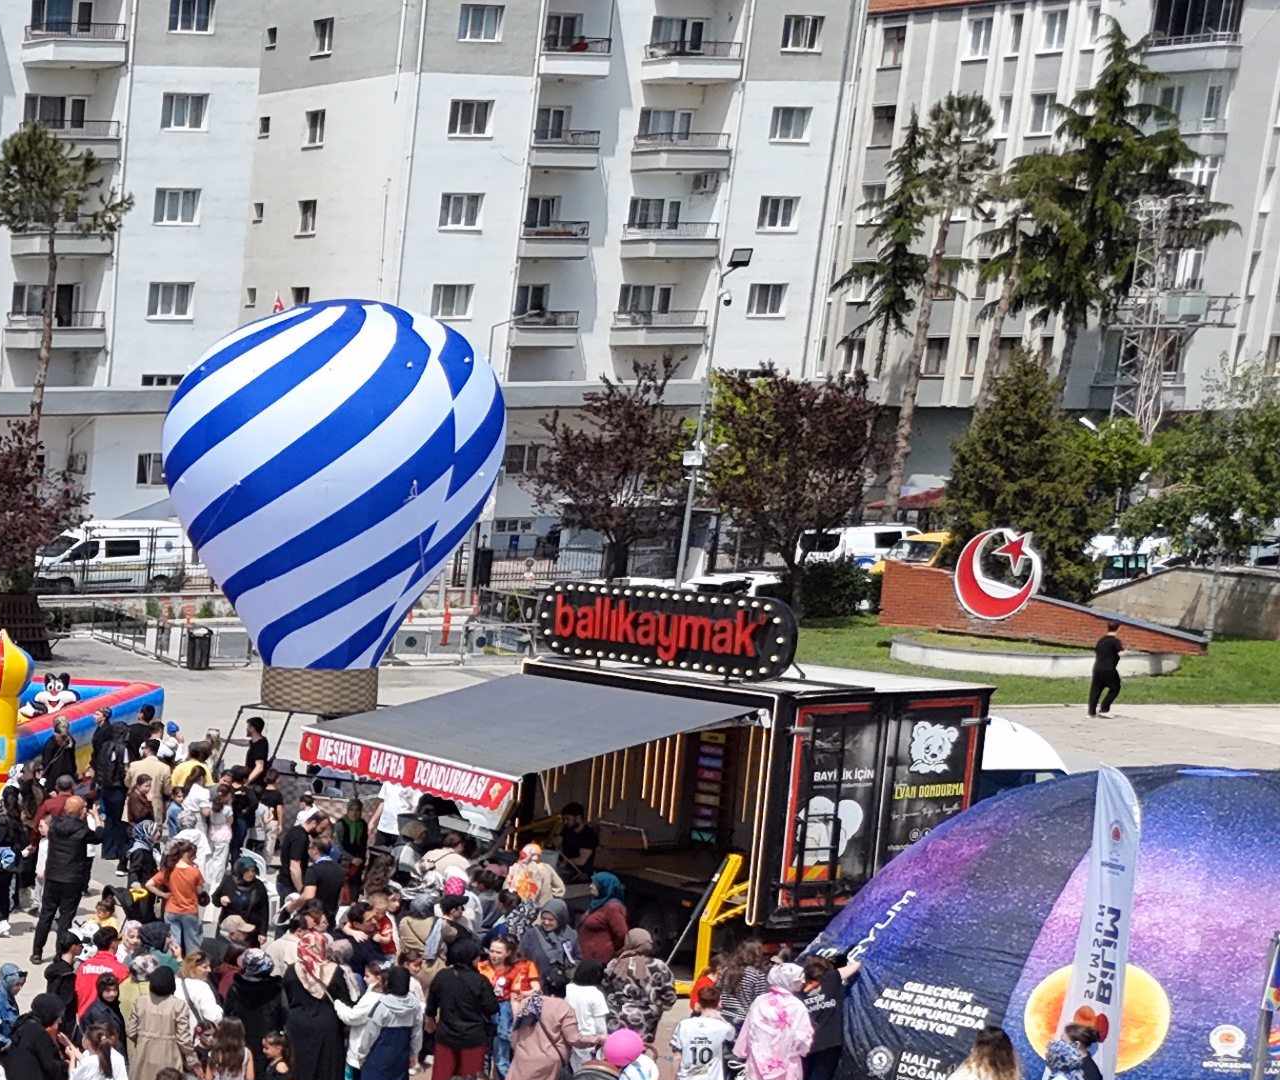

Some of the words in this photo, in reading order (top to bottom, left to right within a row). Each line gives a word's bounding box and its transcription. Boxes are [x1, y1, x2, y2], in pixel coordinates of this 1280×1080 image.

[316, 737, 362, 769] MEŞHUR
[369, 750, 406, 780] BAFRA
[413, 760, 491, 800] DONDURMASI
[813, 768, 854, 782] BAYİİK
[918, 782, 965, 798] DONDURMA
[690, 1046, 713, 1066] 10
